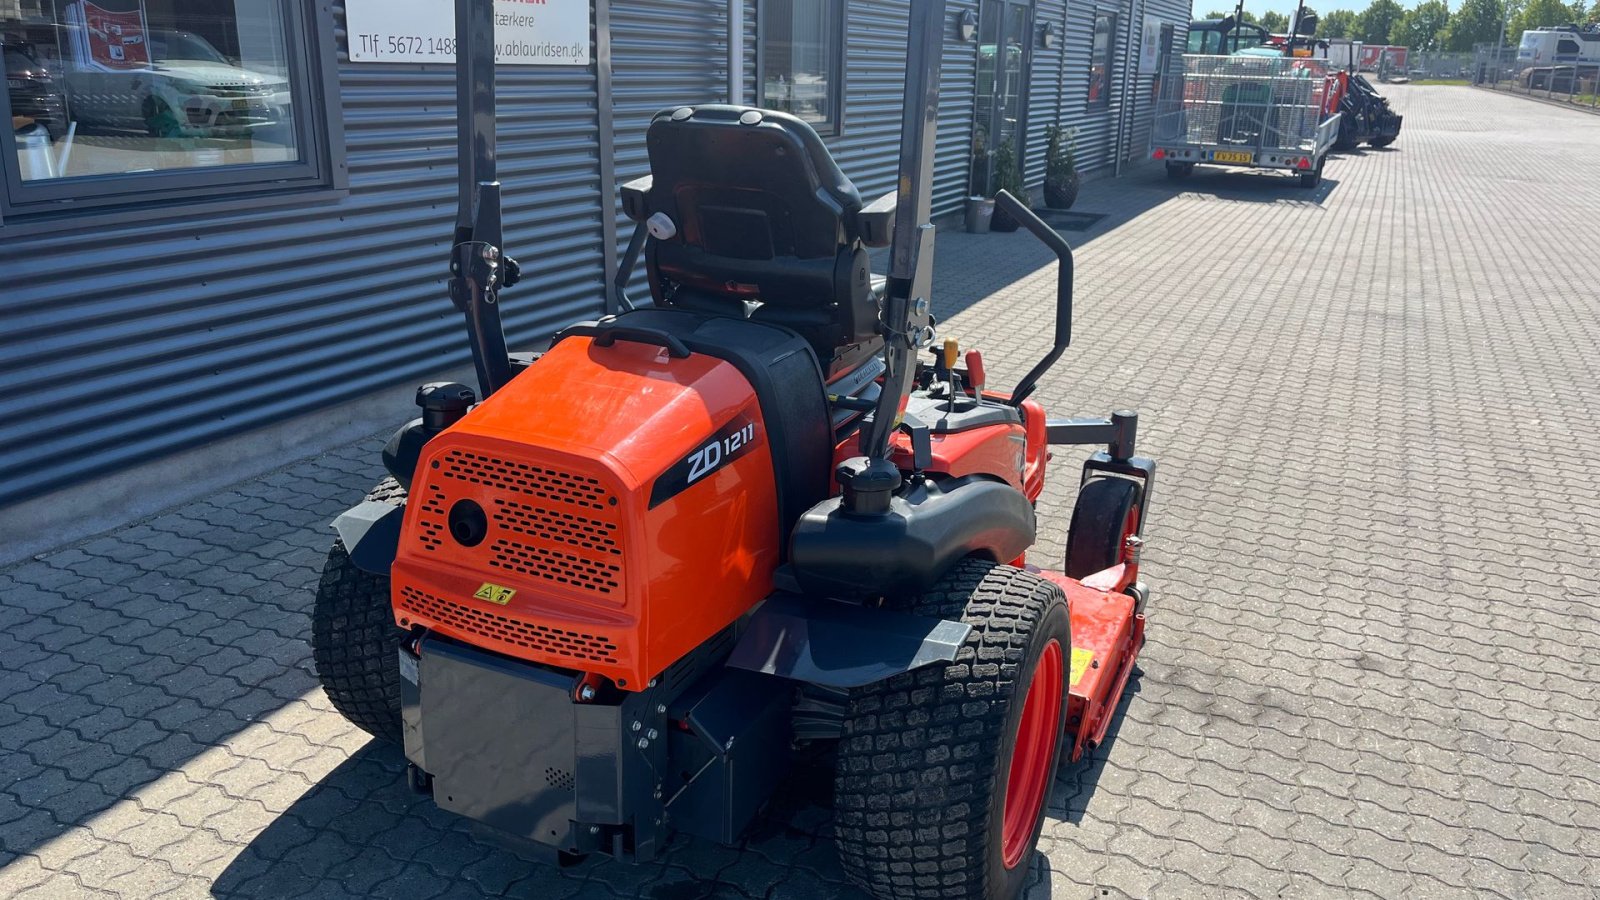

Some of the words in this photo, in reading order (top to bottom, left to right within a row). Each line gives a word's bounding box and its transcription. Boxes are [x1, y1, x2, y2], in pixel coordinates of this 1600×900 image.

[359, 34, 383, 58] Tlf.
[388, 36, 424, 54] 5672
[687, 440, 721, 484] ZD
[724, 422, 754, 456] 1211
